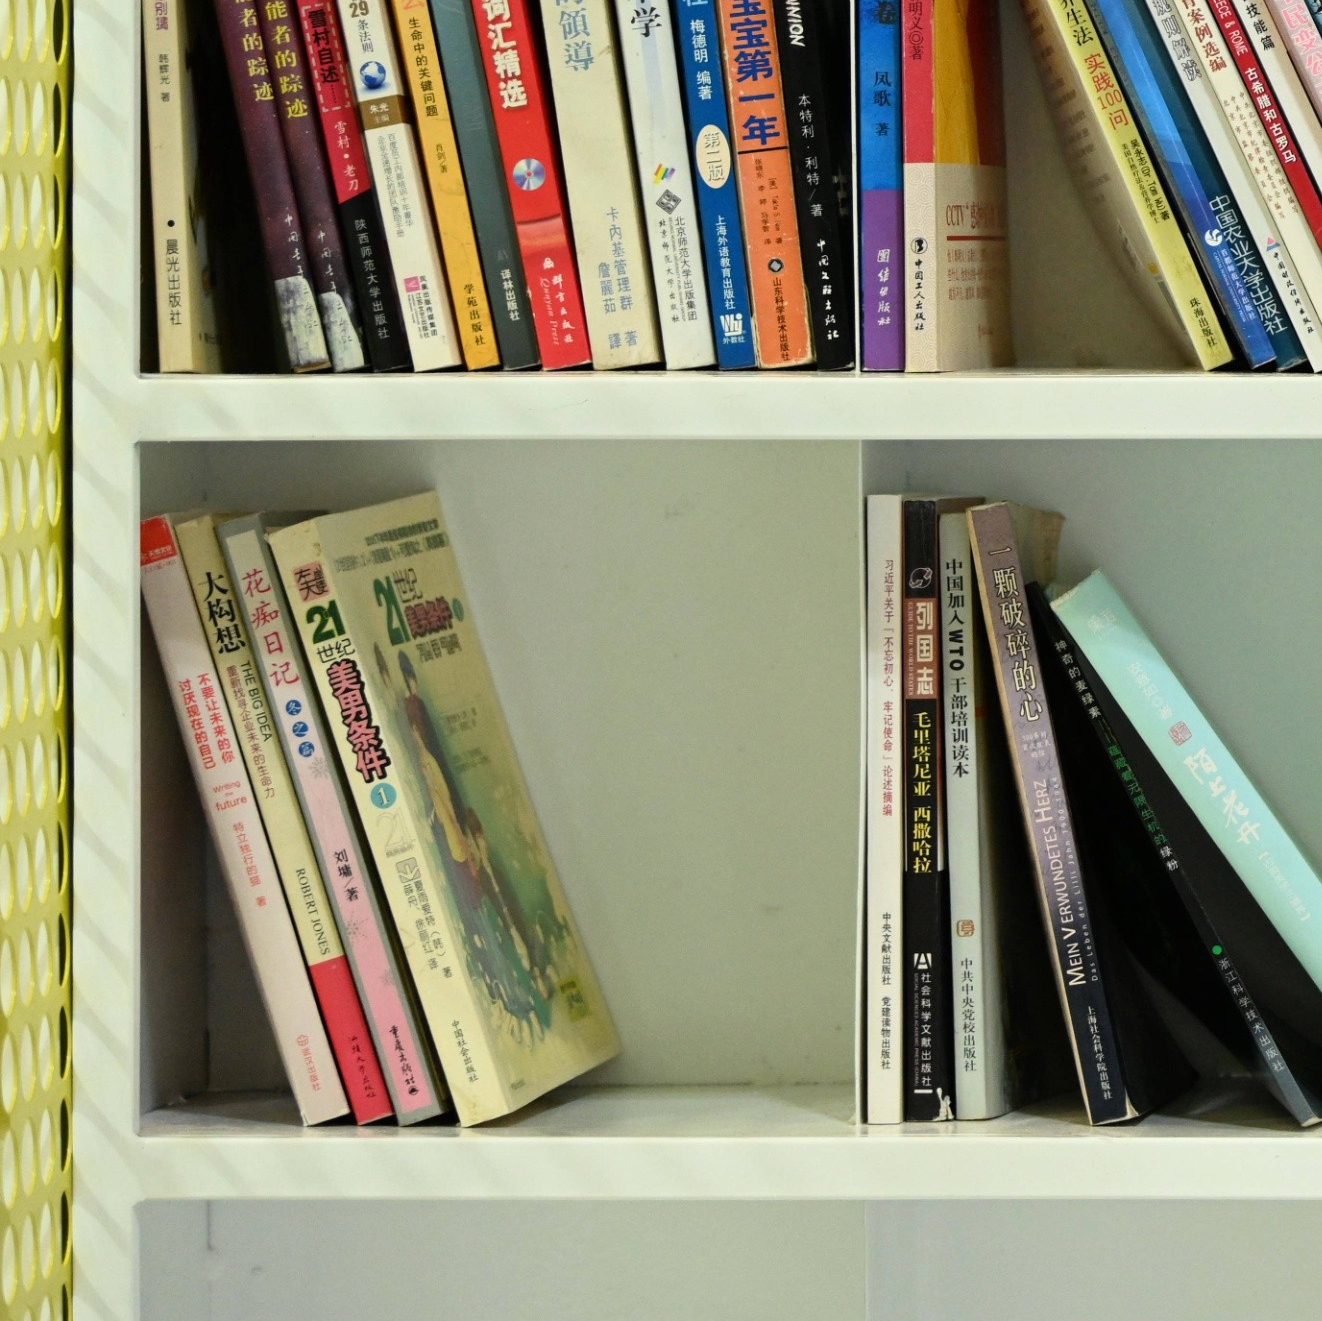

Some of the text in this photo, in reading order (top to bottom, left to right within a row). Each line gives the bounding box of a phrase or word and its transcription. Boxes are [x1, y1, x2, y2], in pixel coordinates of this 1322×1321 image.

[1246, 67, 1297, 164] 古希腊和古罗马
[715, 215, 736, 310] 上海外语教育出版社
[1209, 195, 1288, 336] 中国农业大学出版社
[773, 278, 790, 361] 山东科学技术出版社
[200, 571, 246, 655] 大构想
[242, 568, 300, 688] 花痴日记
[916, 600, 934, 695] 列国志
[989, 544, 1043, 723] 一颗破碎的心
[240, 660, 273, 743] THE BIG IDEA
[945, 557, 968, 778] 中国加入WTO干部培训读本
[327, 660, 392, 783] 美男条件
[912, 711, 932, 874] 毛里塔尼亚 西撒哈拉
[296, 868, 331, 956] ROBERT JONES
[451, 1019, 479, 1082] 中国社会出版社
[920, 973, 932, 1087] 社会科学文献出版社
